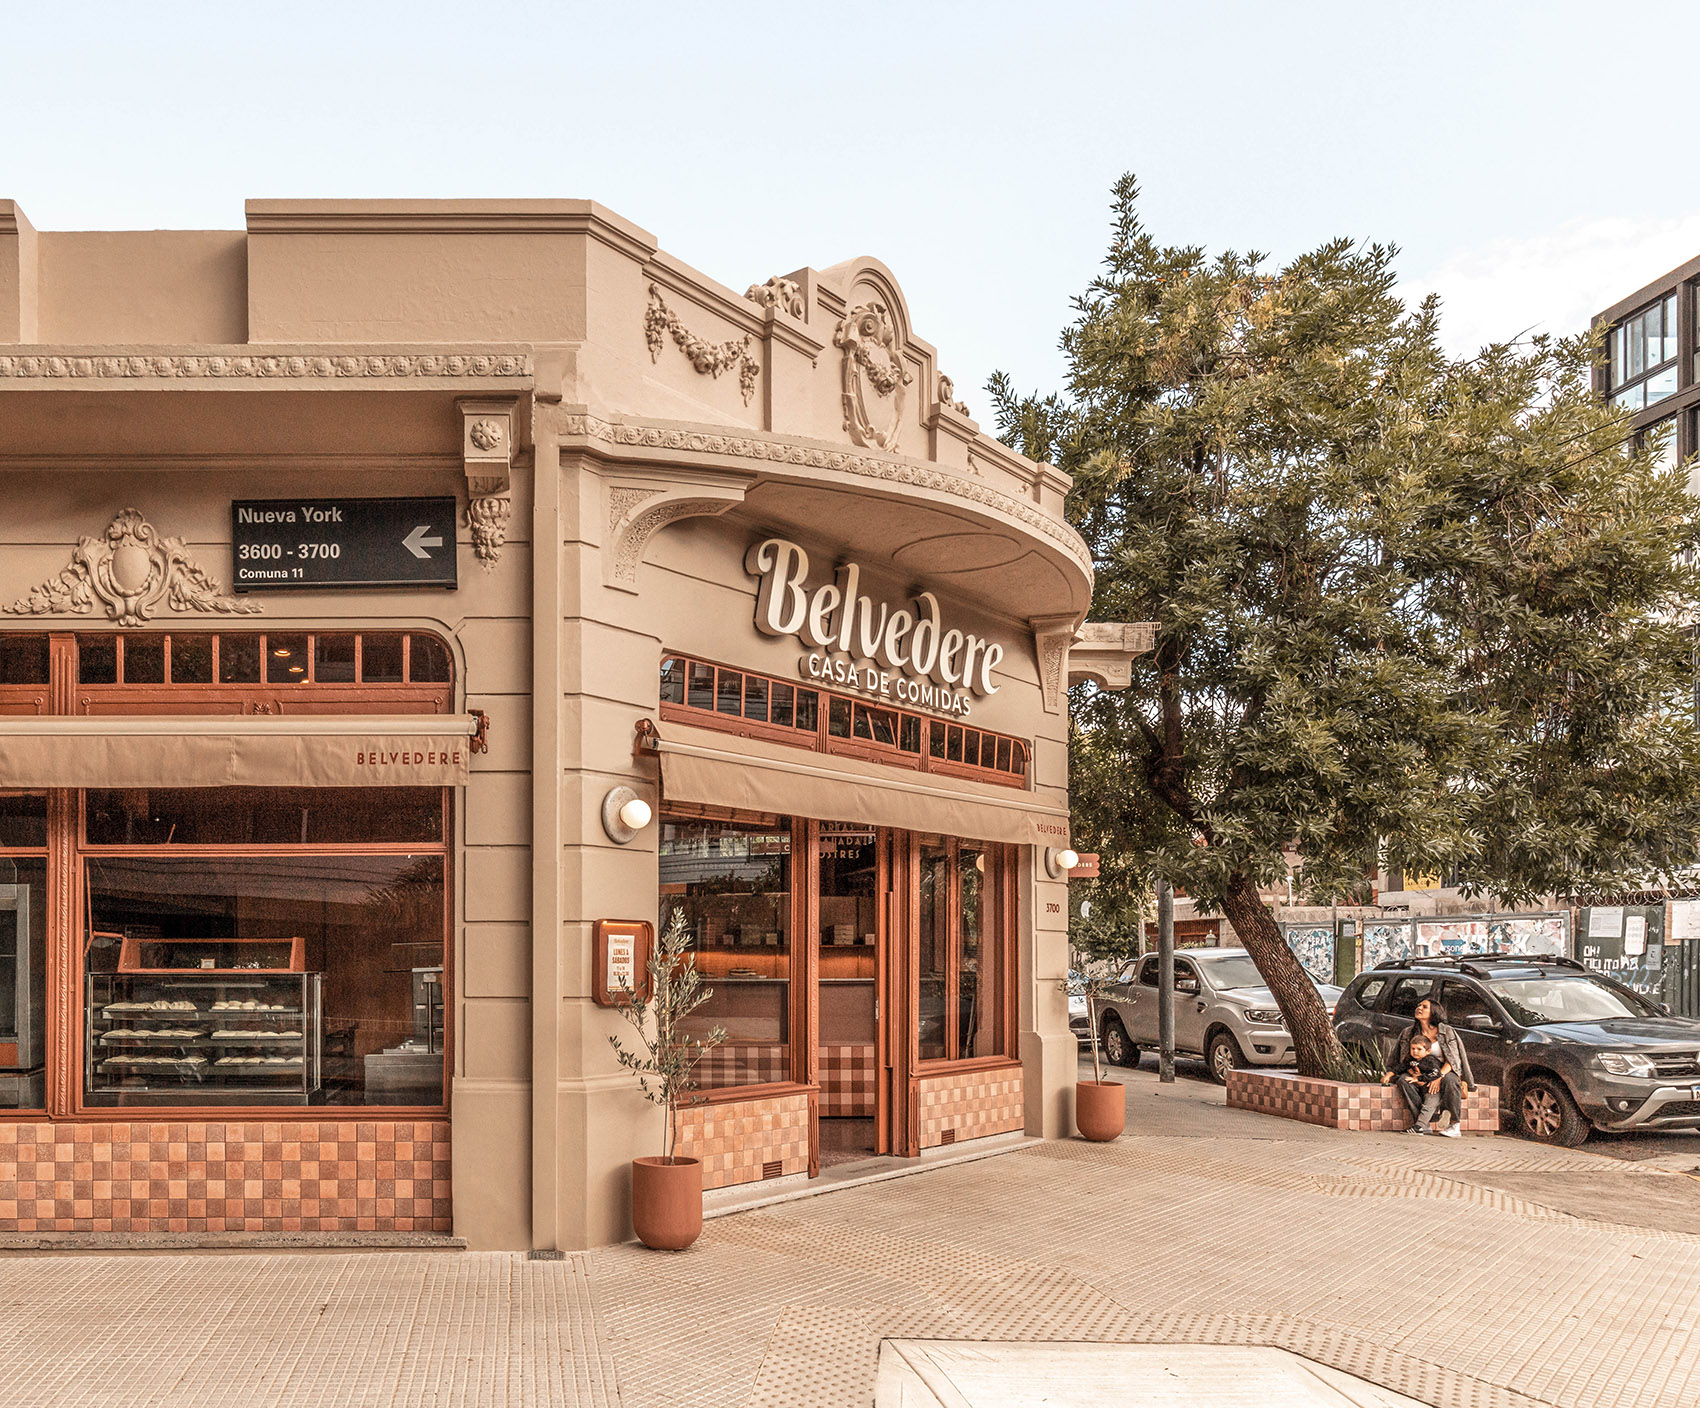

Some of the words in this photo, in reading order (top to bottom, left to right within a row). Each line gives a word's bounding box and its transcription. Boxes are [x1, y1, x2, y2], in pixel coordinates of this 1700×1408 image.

[238, 507, 296, 523] Nueva
[301, 506, 343, 523] York
[239, 543, 282, 560] 3600
[298, 543, 341, 560] 3700
[238, 568, 288, 579] Comuna
[291, 568, 304, 579] 11
[757, 538, 1004, 696] Belvedere
[808, 653, 860, 687] CASA
[866, 668, 890, 694] DE
[896, 677, 972, 717] COMIDAS
[357, 751, 461, 766] BELVEDERE
[1036, 823, 1067, 836] BELVEDERE
[819, 850, 860, 859] OSTRES
[1046, 903, 1060, 914] 3700
